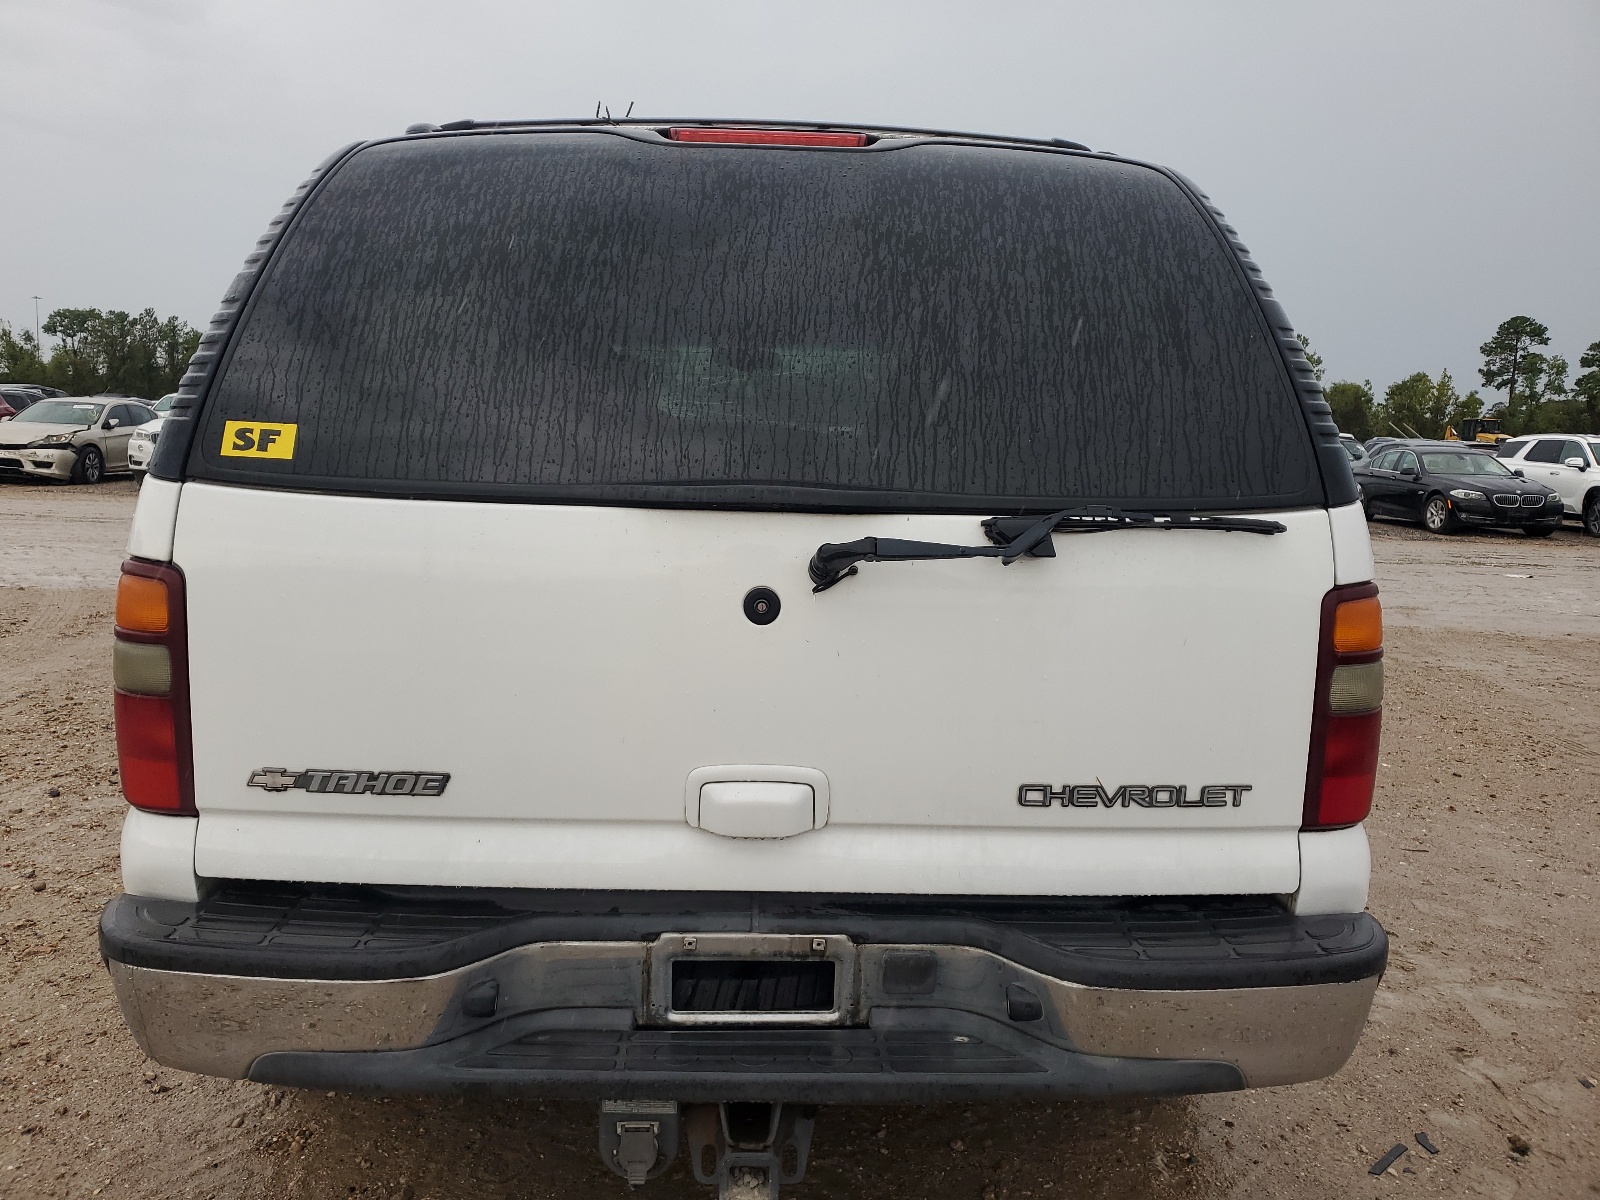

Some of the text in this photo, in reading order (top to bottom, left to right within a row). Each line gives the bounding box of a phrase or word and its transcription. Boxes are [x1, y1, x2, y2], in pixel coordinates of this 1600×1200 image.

[232, 427, 282, 452] SF
[306, 771, 445, 795] TAHOE
[1018, 784, 1252, 808] CHEVROLET
